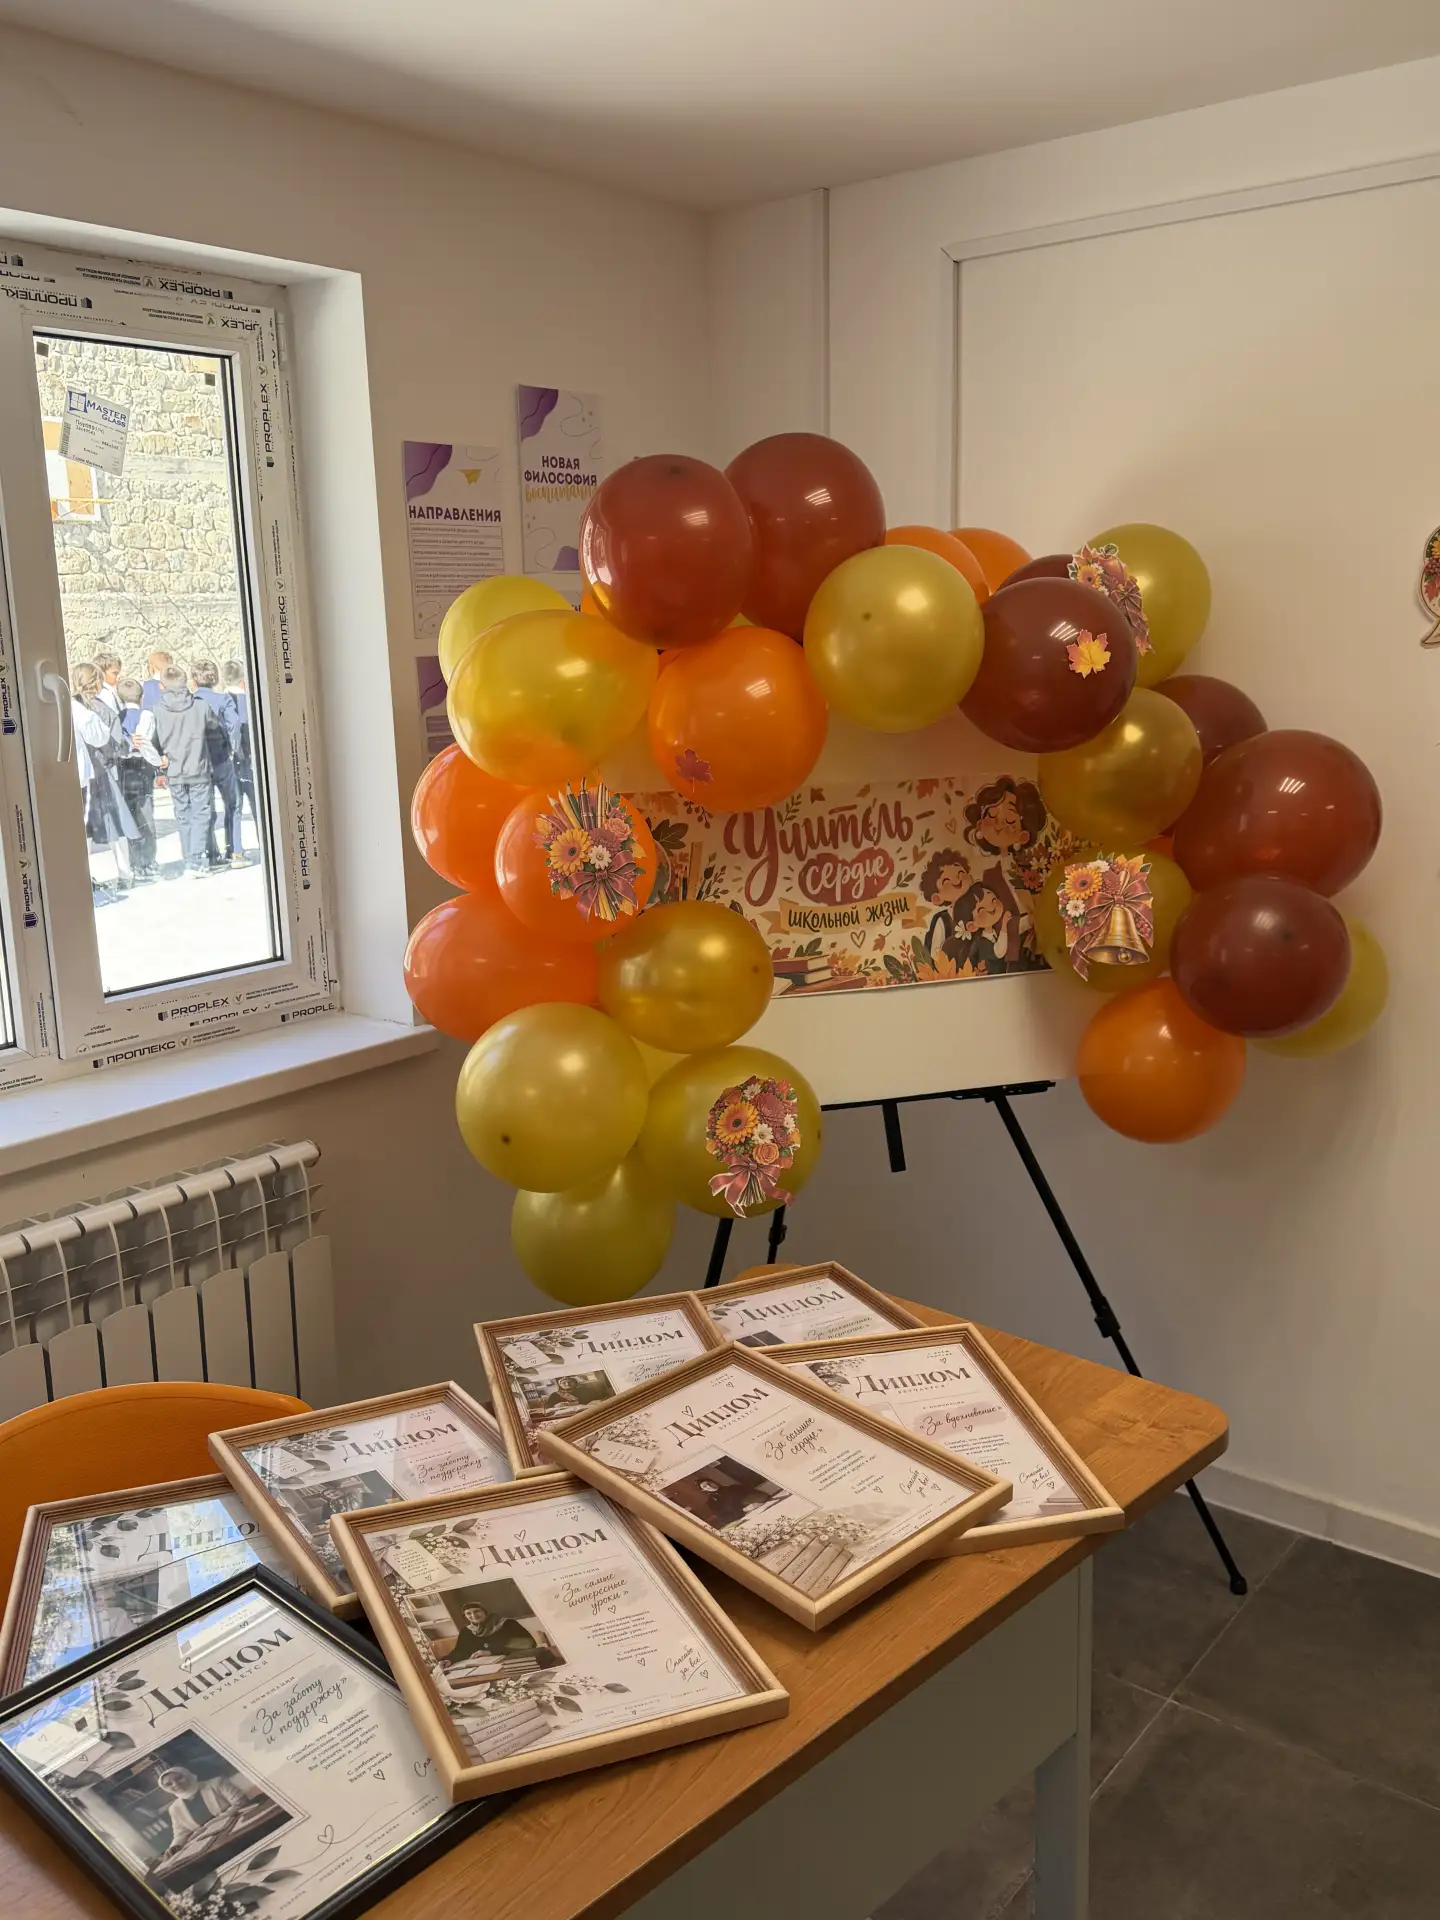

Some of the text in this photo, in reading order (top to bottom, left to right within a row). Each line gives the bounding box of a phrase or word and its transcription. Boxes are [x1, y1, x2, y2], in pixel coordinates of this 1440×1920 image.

[159, 279, 221, 299] PROPLEX
[87, 399, 127, 421] MASTER
[101, 414, 126, 428] GLASS
[260, 383, 272, 453] PROPLEX
[542, 455, 580, 470] НОВАЯ
[524, 470, 597, 486] ФИЛОСОФИЯ
[408, 505, 501, 522] НАПРАВЛЕНИЯ
[278, 596, 291, 670] ПРОПЛЕКС
[297, 815, 309, 877] PROPLEX
[171, 997, 230, 1018] PROPLEX
[107, 1040, 176, 1065] ПРОПЛЕКС
[584, 1573, 617, 1589] самые
[568, 1579, 627, 1609] интересные
[203, 1661, 269, 1701] ВРУЧАЕТСЯ
[284, 1677, 325, 1715] заботу
[266, 1677, 348, 1745] и поддержку»
